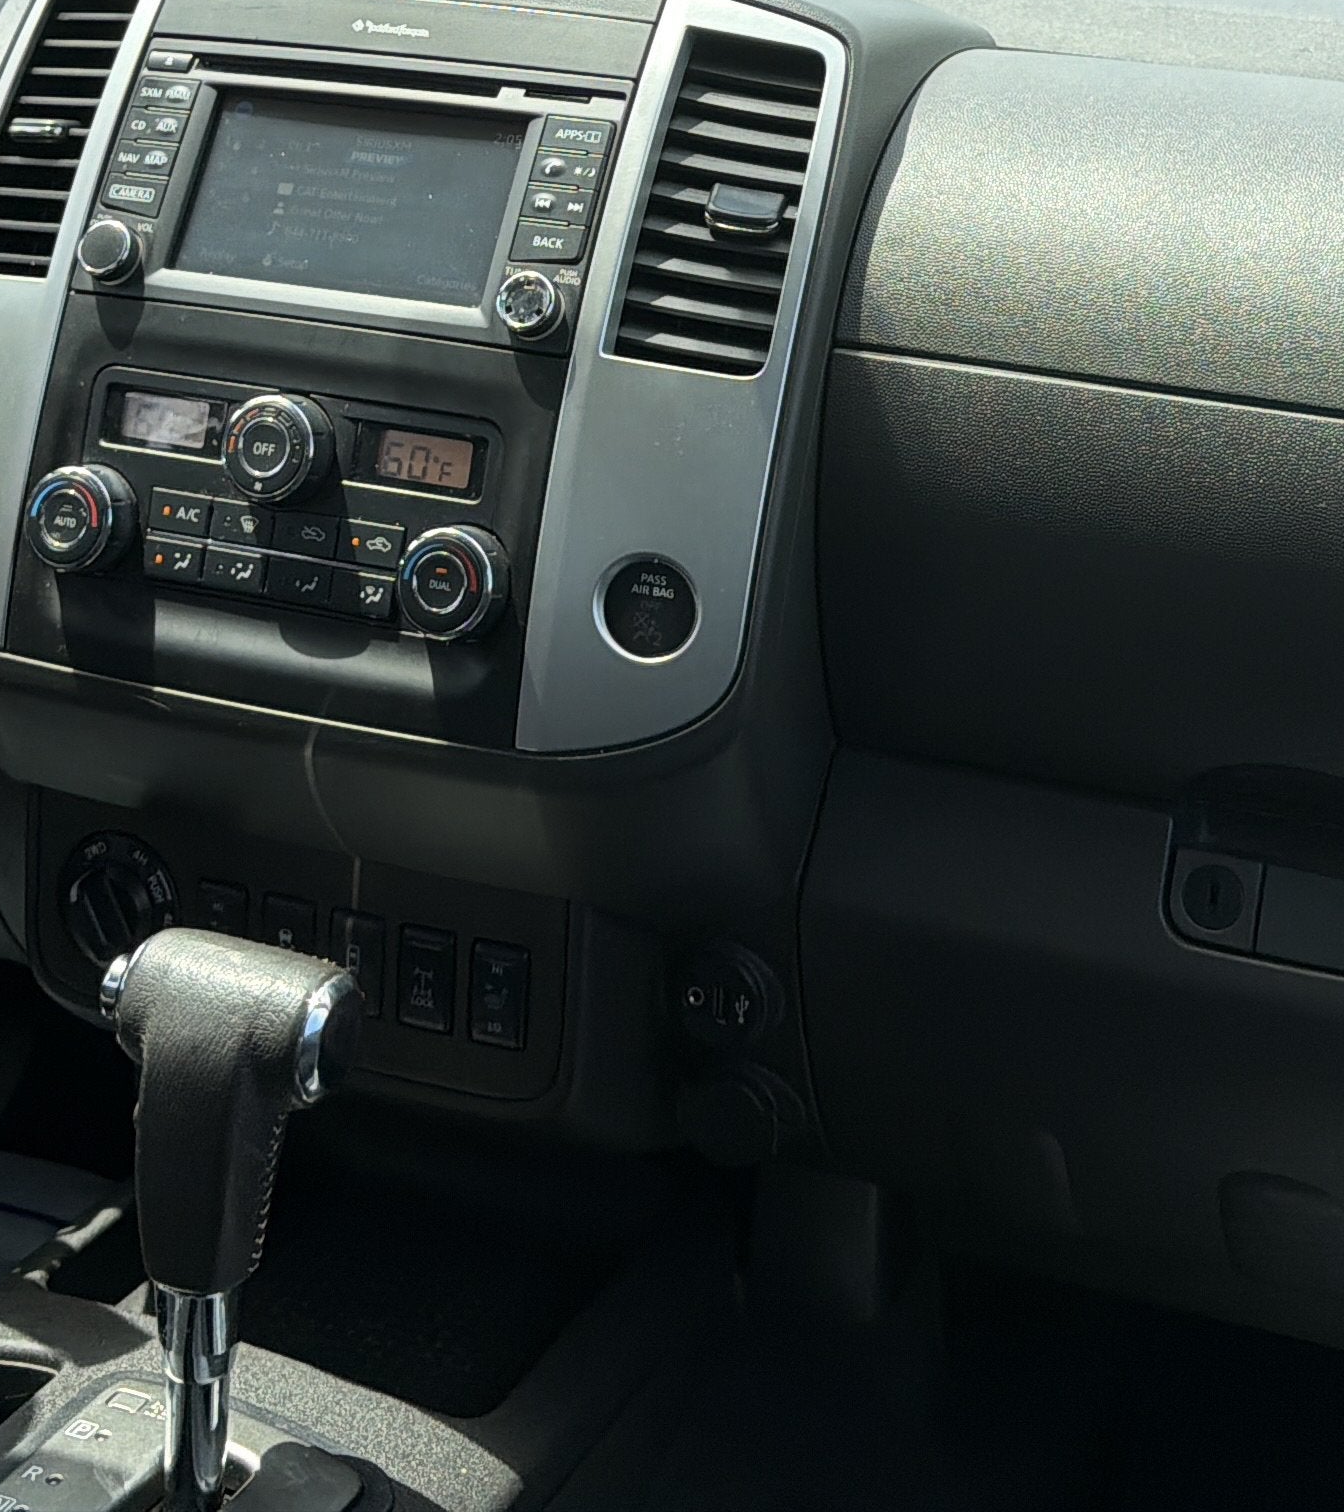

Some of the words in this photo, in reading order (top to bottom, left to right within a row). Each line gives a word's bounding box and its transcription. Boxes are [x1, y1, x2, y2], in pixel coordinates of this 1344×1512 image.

[140, 86, 163, 98] SXM
[130, 119, 146, 131] CD
[156, 120, 179, 134] AUX
[554, 128, 584, 140] APPS
[117, 152, 140, 164] NAV
[143, 153, 169, 166] MAP
[111, 186, 153, 200] CAMERA
[137, 222, 154, 233] VOL
[531, 235, 565, 250] BACK
[553, 273, 581, 286] AUDIO
[252, 442, 277, 457] OFF
[175, 506, 200, 523] A/C
[53, 515, 77, 529] AUTO
[428, 577, 452, 593] DUAL
[641, 572, 667, 586] PASS
[631, 583, 650, 596] AIR
[652, 586, 675, 600] BAG
[84, 841, 107, 860] 2WD
[21, 1464, 44, 1482] R
